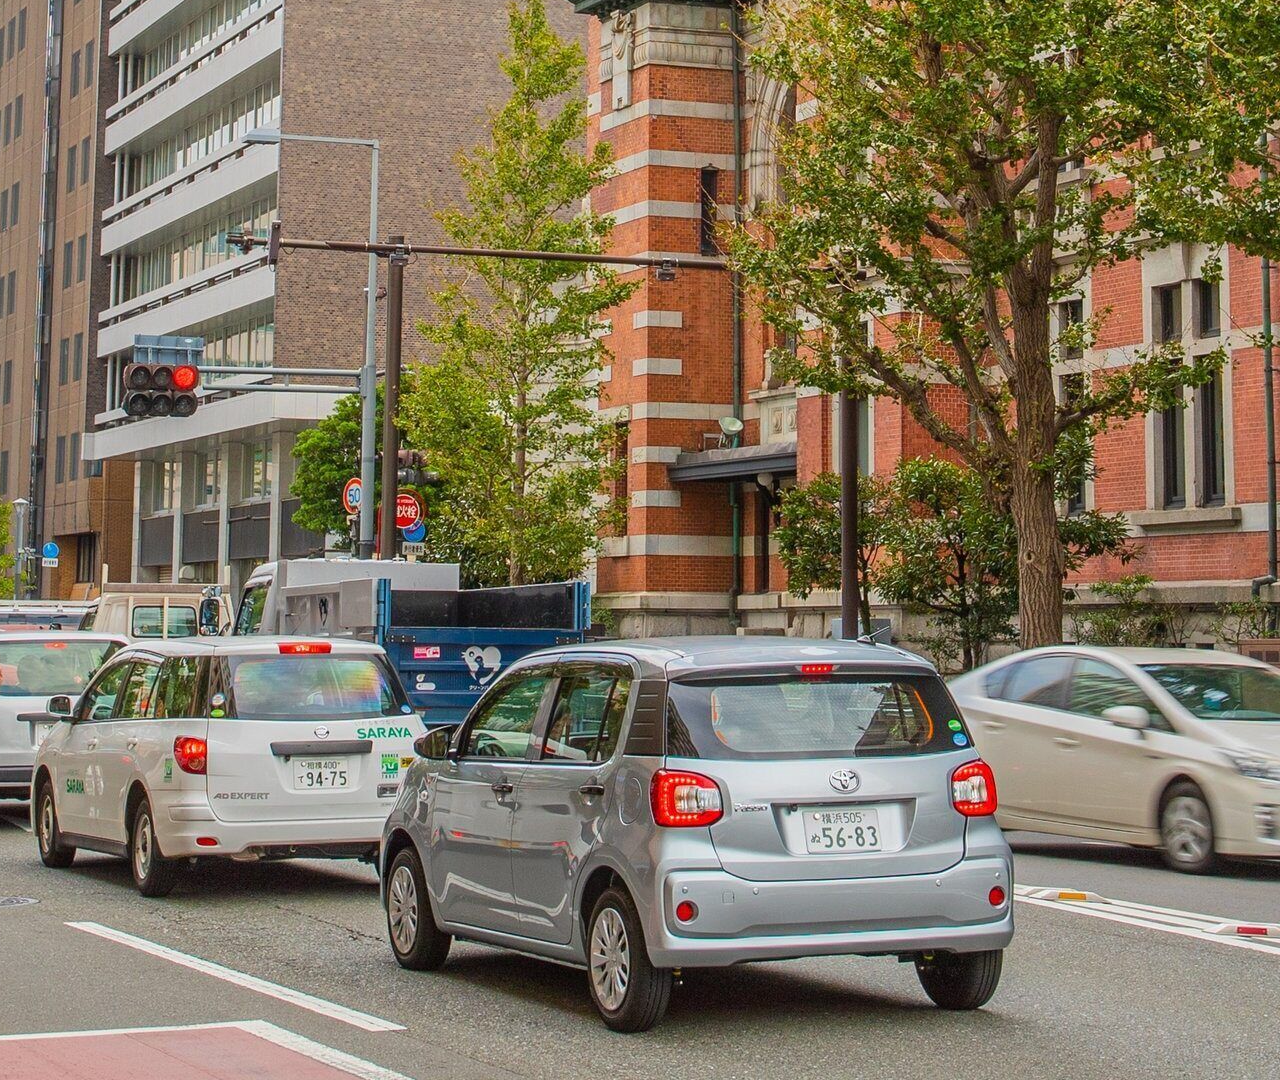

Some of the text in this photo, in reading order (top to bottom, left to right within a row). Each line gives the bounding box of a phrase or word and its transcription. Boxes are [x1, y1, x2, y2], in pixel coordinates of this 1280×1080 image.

[348, 487, 360, 504] 50
[357, 727, 412, 739] SARAYA
[66, 778, 85, 794] SARAYA
[306, 770, 347, 787] 94-75
[231, 792, 270, 800] EXPERT
[734, 803, 769, 813] Passo
[810, 825, 878, 849] ぬ 56-83
